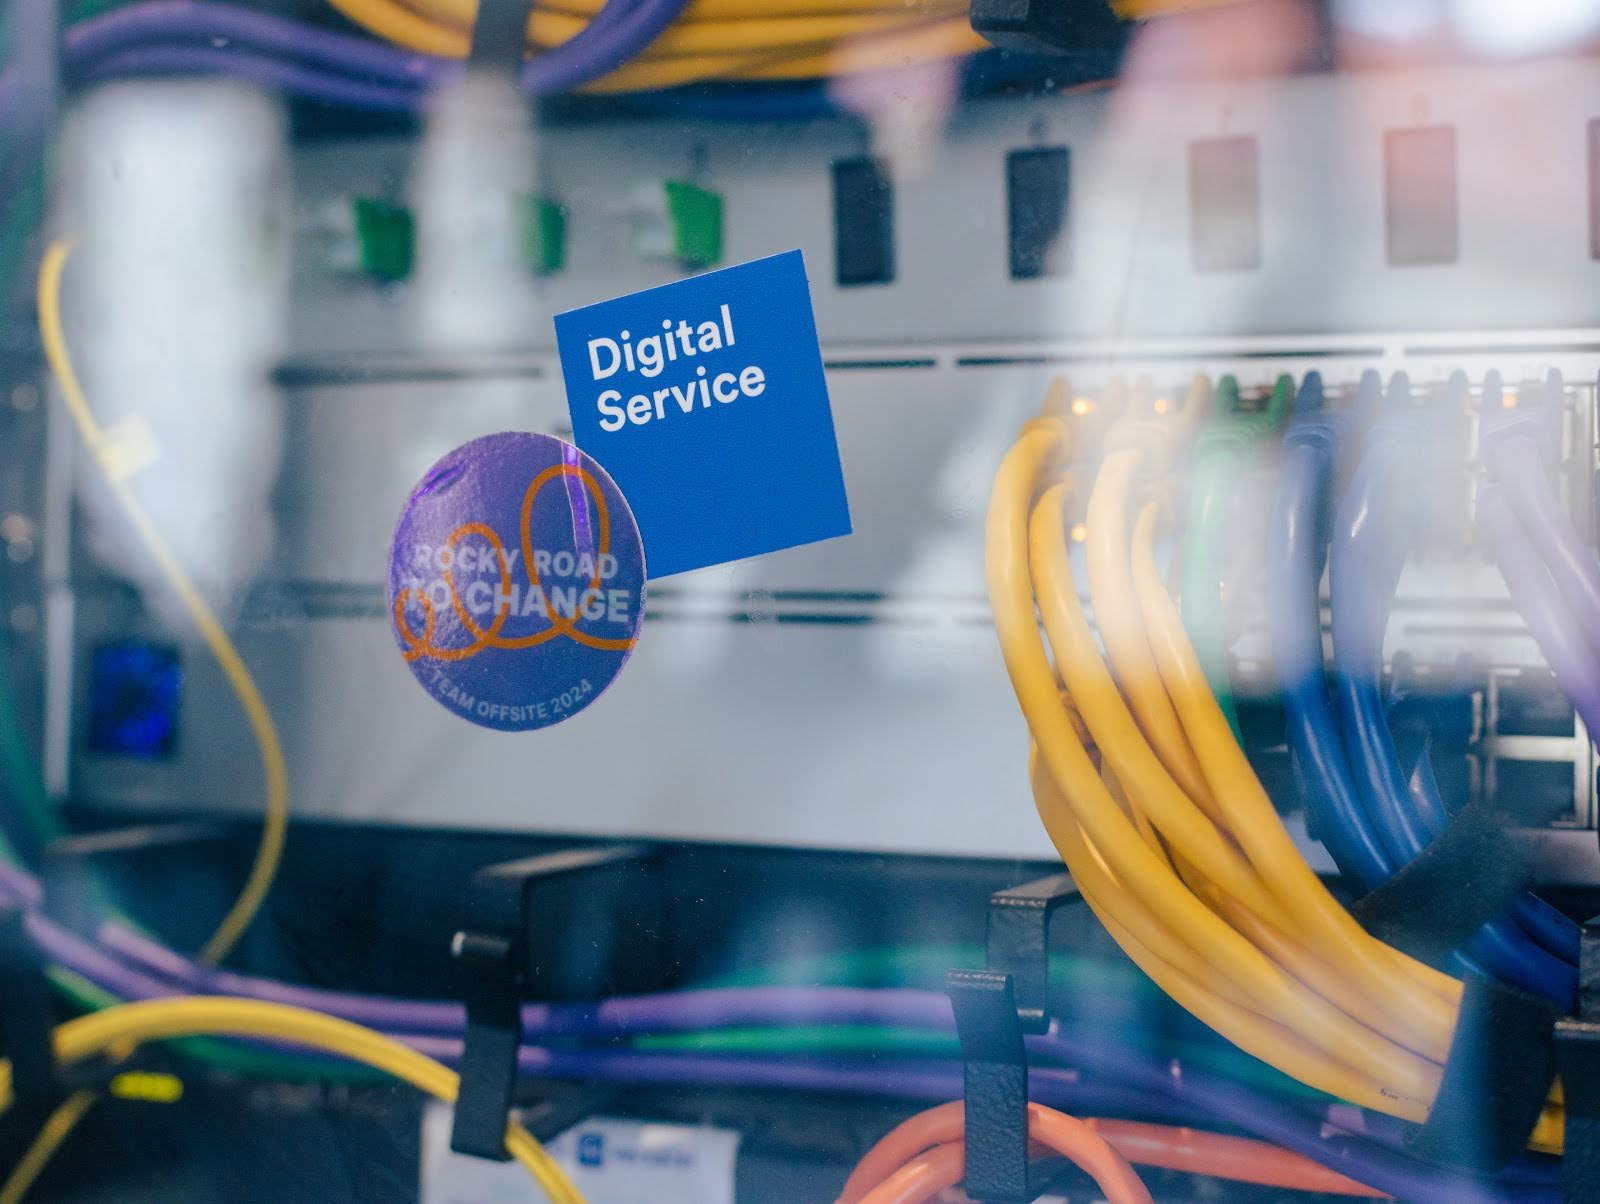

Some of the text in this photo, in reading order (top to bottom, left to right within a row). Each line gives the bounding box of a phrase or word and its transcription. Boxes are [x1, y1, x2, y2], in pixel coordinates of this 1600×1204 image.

[587, 304, 736, 382] Digital
[596, 365, 767, 433] Service
[414, 543, 619, 580] ROCKY ROAD
[401, 577, 630, 623] TO CHANGE
[432, 669, 593, 722] TEAM OFFSITE 2024
